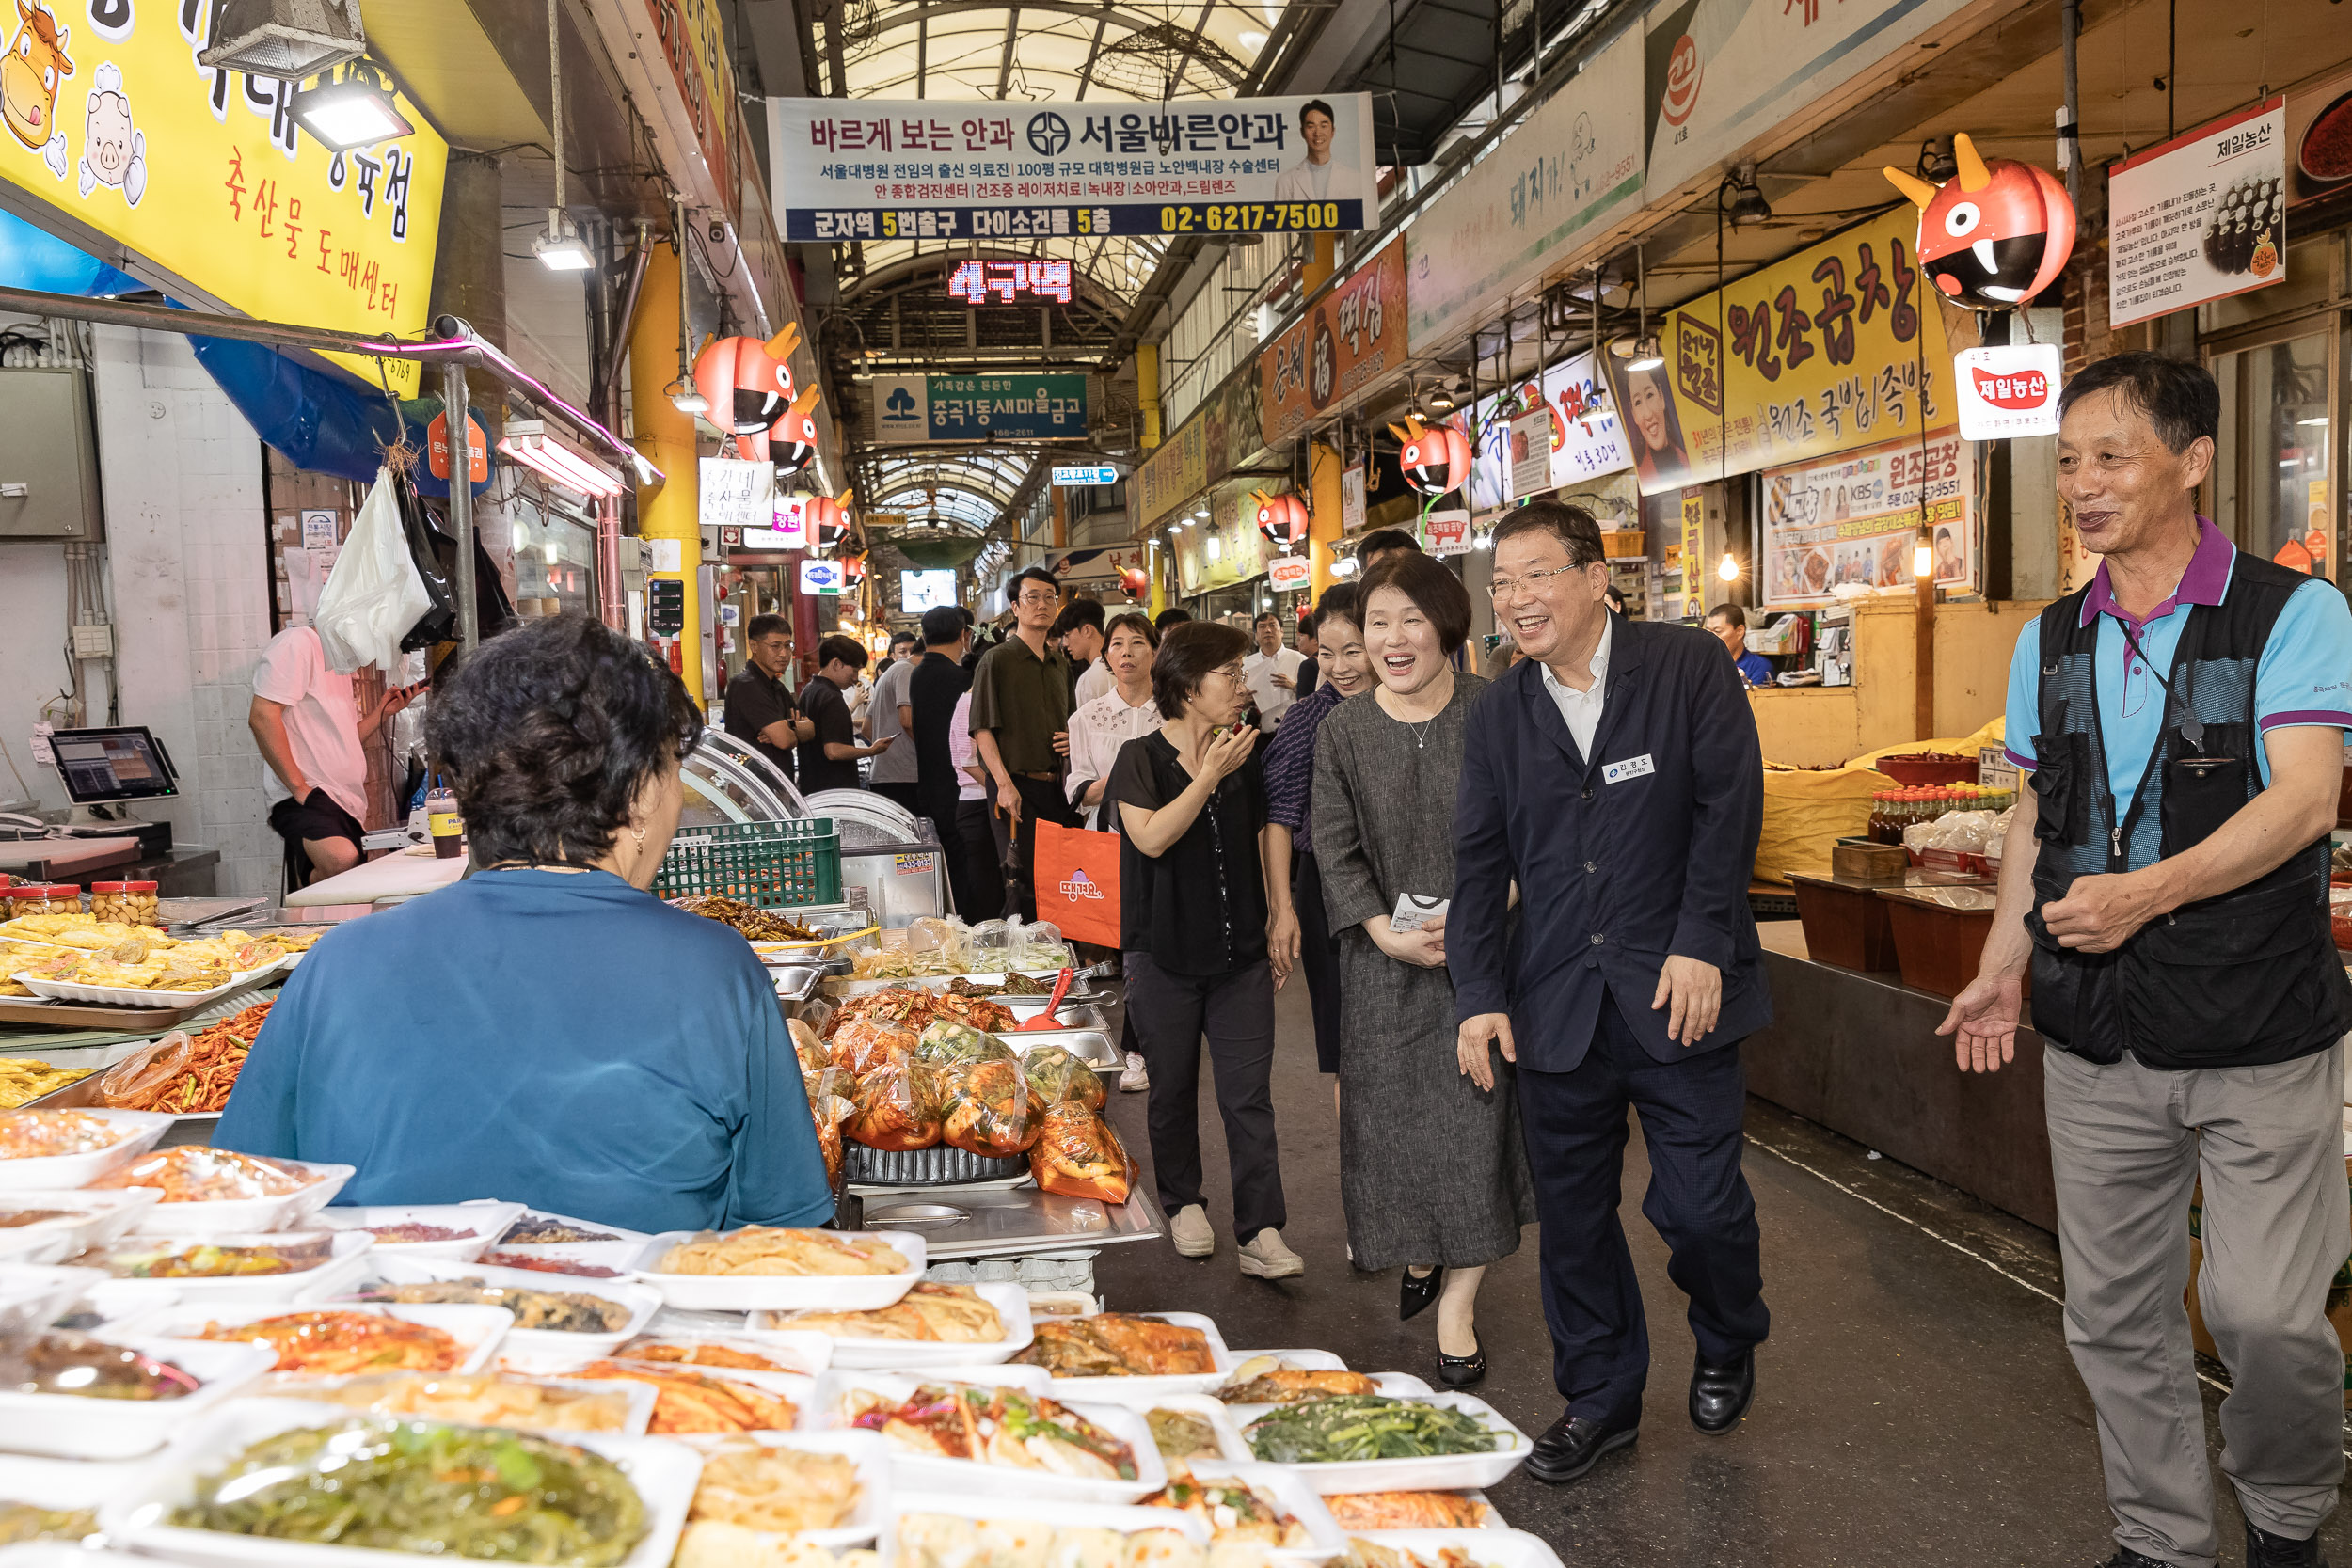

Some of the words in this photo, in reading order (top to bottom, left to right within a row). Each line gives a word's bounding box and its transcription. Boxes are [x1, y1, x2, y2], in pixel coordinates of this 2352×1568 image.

[810, 118, 893, 153] 바르게
[900, 119, 954, 151] 보는
[961, 117, 1015, 151] 안과
[1079, 113, 1288, 152] 서울바른안과
[2217, 123, 2272, 159] 제일농산
[820, 163, 889, 180] 서울대병원
[894, 163, 934, 179] 전임의
[938, 163, 965, 178] 출신
[969, 162, 1009, 178] 의료진
[1017, 161, 1055, 177] 100평
[1058, 162, 1086, 176] 규모
[1089, 160, 1155, 177] 대학병원급
[1159, 159, 1225, 175] 노안백내장
[1228, 158, 1279, 174] 수술센터
[875, 185, 887, 199] 안
[892, 183, 969, 199] 종합검진센터
[977, 182, 1014, 198] 건조증
[1018, 182, 1082, 198] 레이저치료
[1088, 181, 1125, 197] 녹내장
[225, 146, 303, 259] 축산물
[317, 229, 397, 320] 도매센터
[815, 212, 875, 237] 군자역
[882, 210, 957, 237] 5번출구
[972, 209, 1070, 236] 다이소건물
[1077, 207, 1111, 234] 5층
[1161, 203, 1339, 232] 02-6217-7500
[1727, 237, 1918, 382] 원조곱창
[1979, 375, 2046, 401] 제일농산
[1769, 398, 1815, 443] 원조
[1889, 440, 1960, 490] 원조곱창
[1851, 483, 1872, 502] KBS
